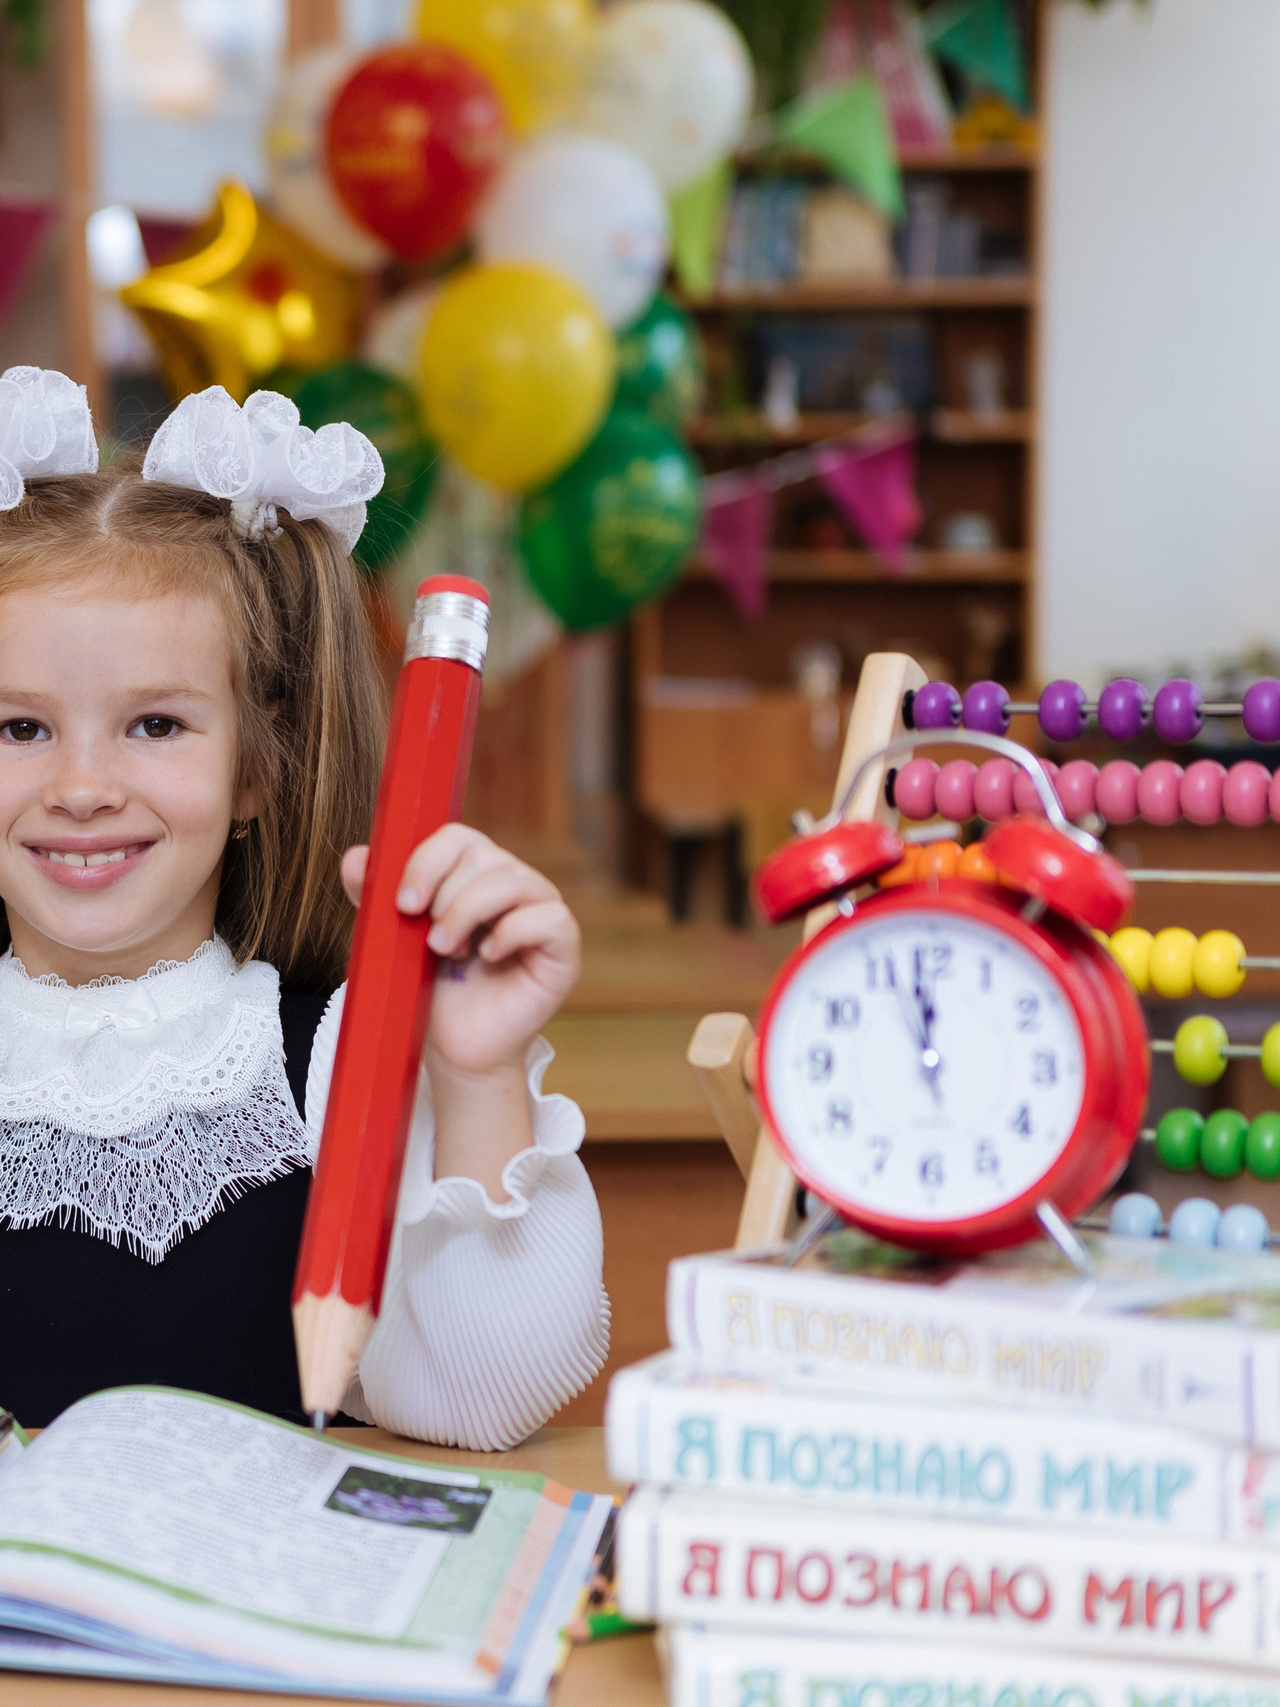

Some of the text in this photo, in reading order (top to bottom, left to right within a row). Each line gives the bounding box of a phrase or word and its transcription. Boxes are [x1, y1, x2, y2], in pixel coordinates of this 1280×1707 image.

[913, 945, 953, 979] 12
[980, 957, 992, 990] 1
[826, 996, 860, 1028] 10
[1017, 994, 1040, 1030] 2
[809, 1045, 833, 1083] 9
[1034, 1051, 1057, 1086] 3
[828, 1098, 853, 1135] 8
[1010, 1103, 1032, 1137] 4
[867, 1136, 891, 1174] 7
[919, 1152, 943, 1185] 6
[974, 1138, 999, 1175] 5
[727, 1292, 756, 1347] Я
[772, 1304, 974, 1376] ПОЗНАЮ
[994, 1336, 1109, 1396] МИР
[676, 1416, 1197, 1520] Я ПОЗНАЮ МИР
[682, 1543, 1236, 1634] Я ПОЗНАЮ МИР
